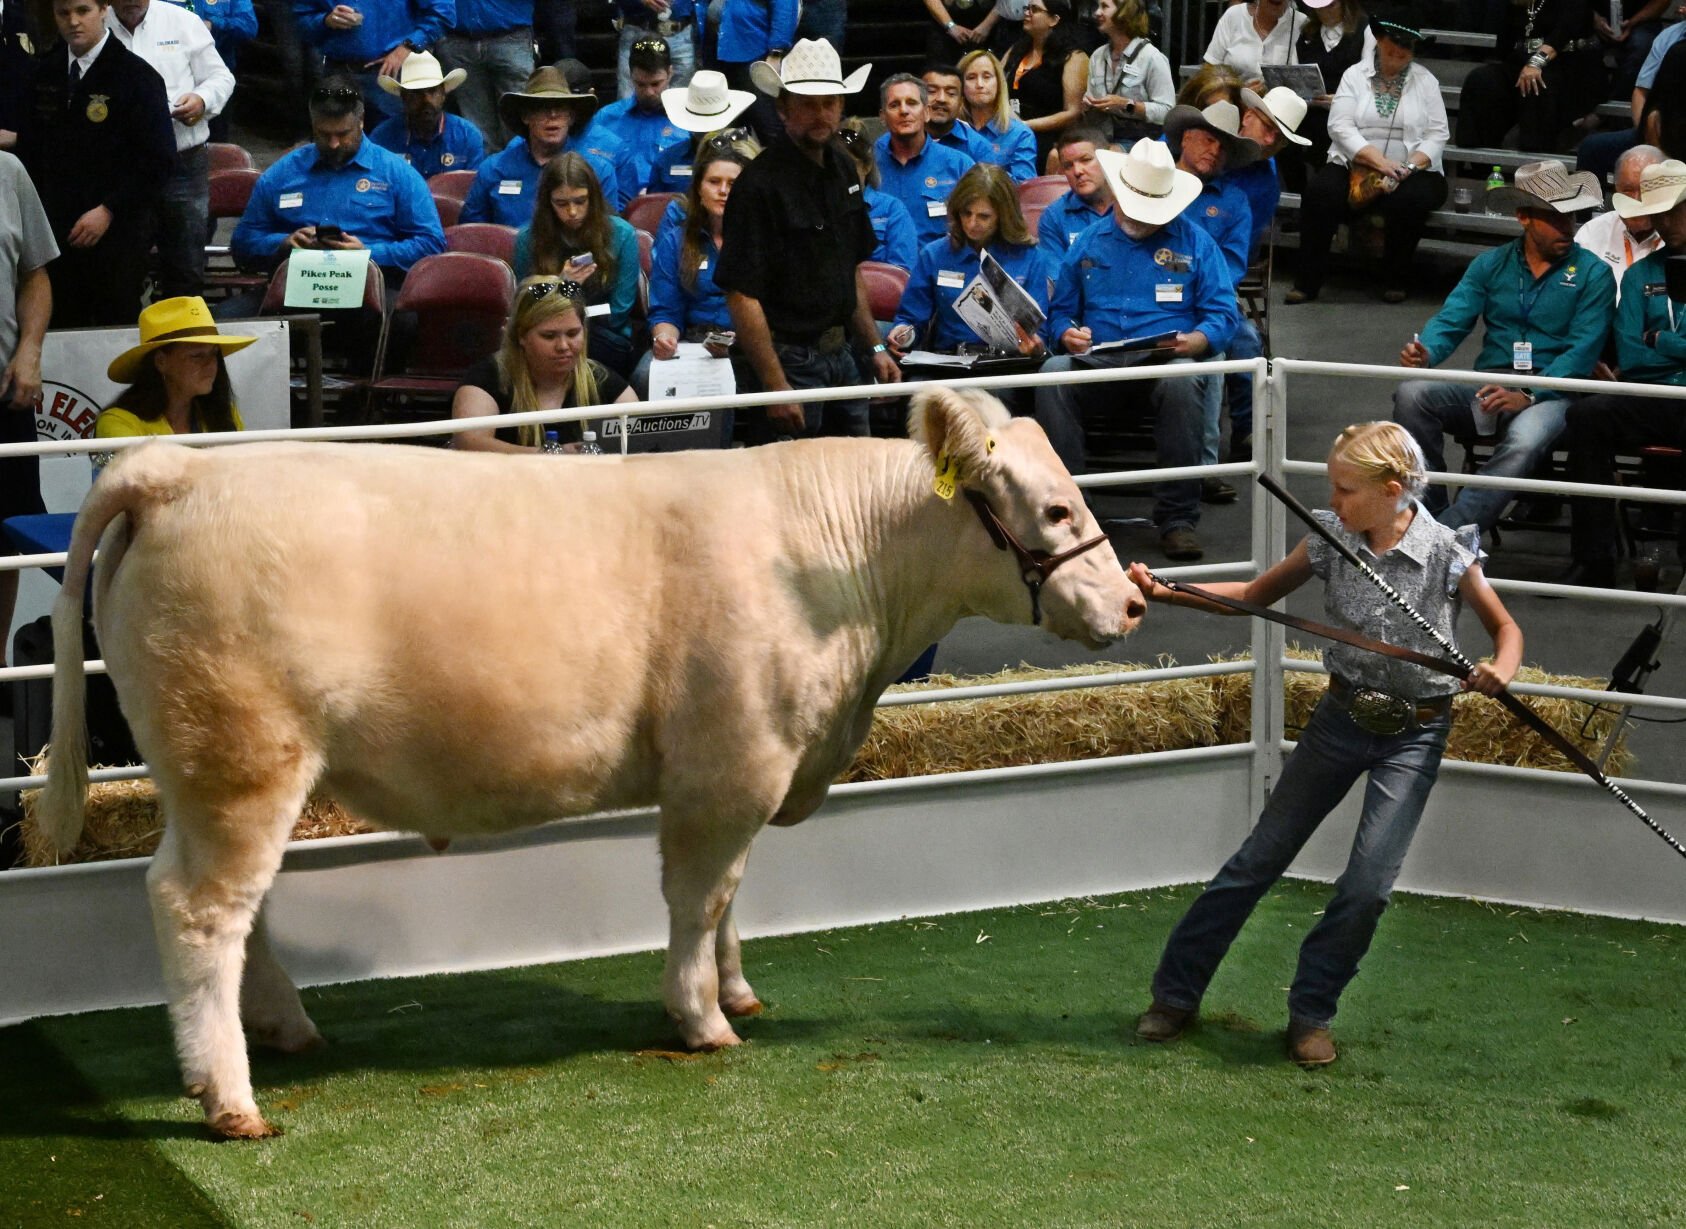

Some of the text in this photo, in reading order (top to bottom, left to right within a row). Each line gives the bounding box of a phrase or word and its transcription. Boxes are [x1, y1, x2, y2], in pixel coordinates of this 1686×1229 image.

[301, 269, 352, 278] Pikes Peak
[312, 283, 338, 291] Posse
